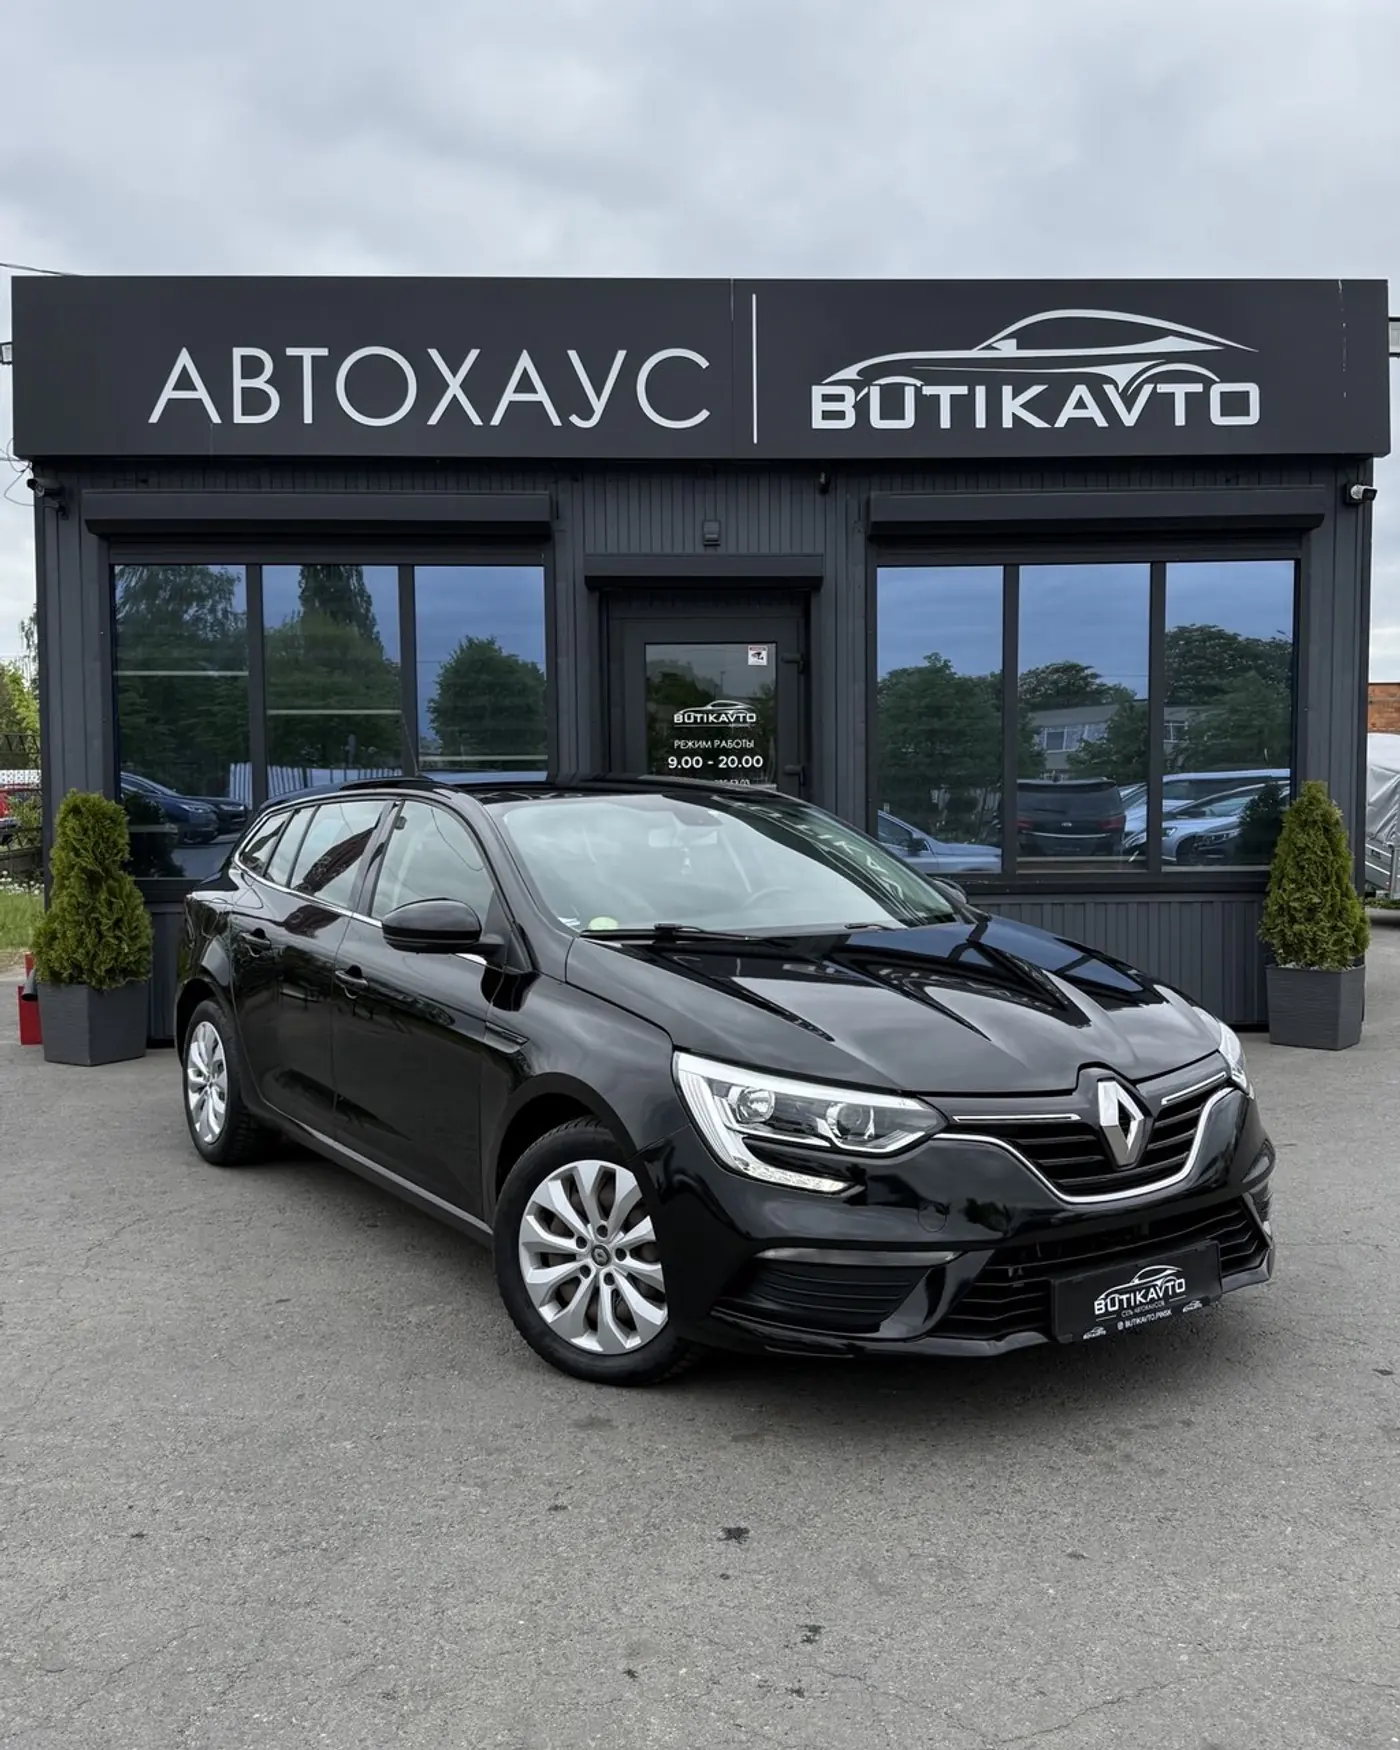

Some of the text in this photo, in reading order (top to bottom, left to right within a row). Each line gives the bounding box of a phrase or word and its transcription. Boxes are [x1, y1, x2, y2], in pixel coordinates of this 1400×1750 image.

[148, 345, 711, 429] АВТОХАУС
[811, 382, 1260, 430] BUTIKAVTO
[673, 712, 757, 723] BUTIKAVTO
[673, 739, 755, 750] РЕЖИМ РАБОТЫ
[667, 755, 703, 769] 9.00
[718, 755, 764, 769] 20.00
[1094, 1278, 1185, 1315] BUTIKAVTO
